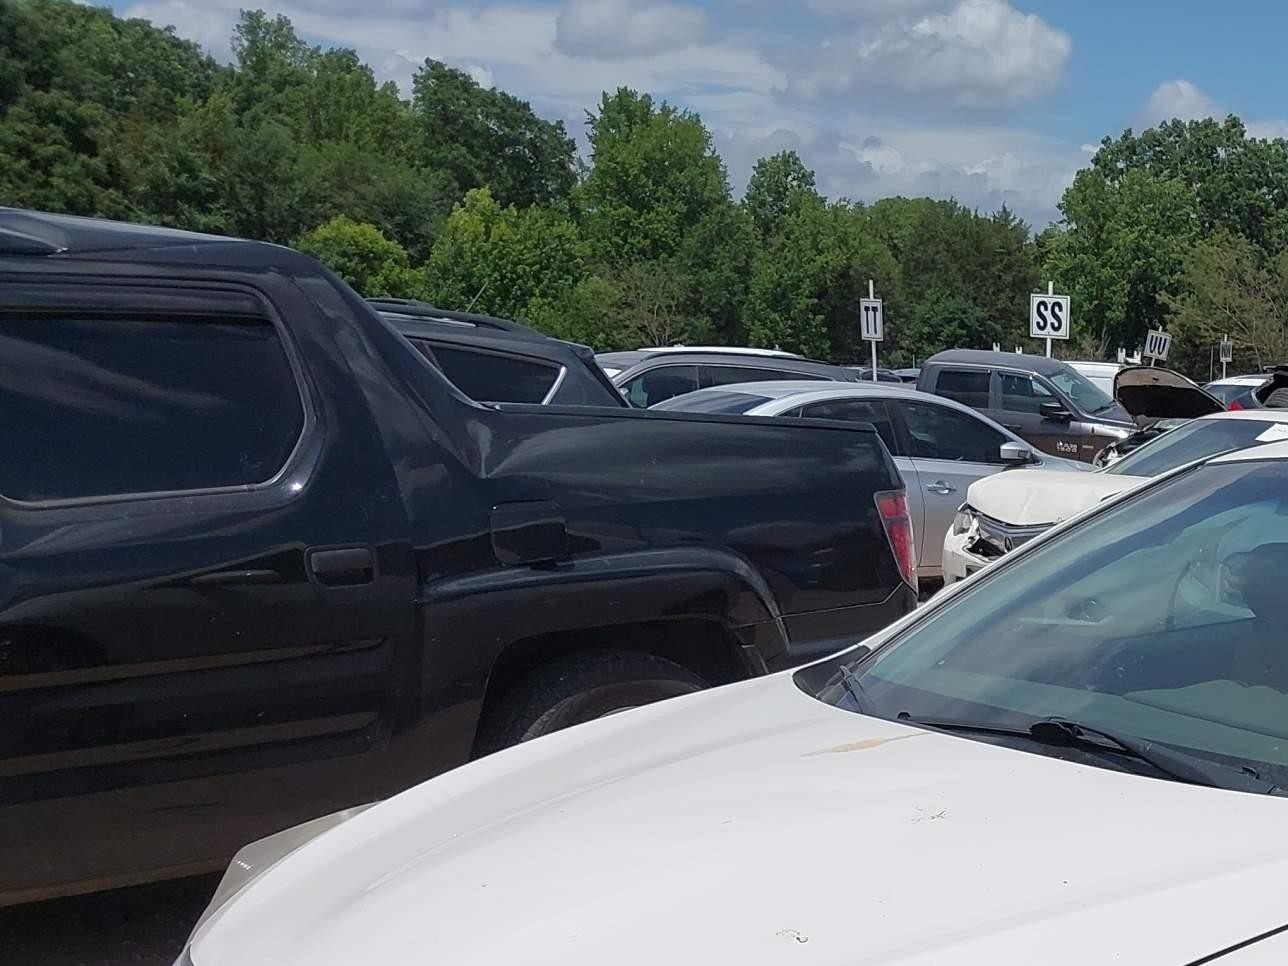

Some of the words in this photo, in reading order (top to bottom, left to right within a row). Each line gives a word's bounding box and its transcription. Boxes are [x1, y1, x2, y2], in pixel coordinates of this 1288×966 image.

[863, 305, 879, 335] TT
[1035, 299, 1064, 332] SS
[1149, 334, 1168, 356] UU
